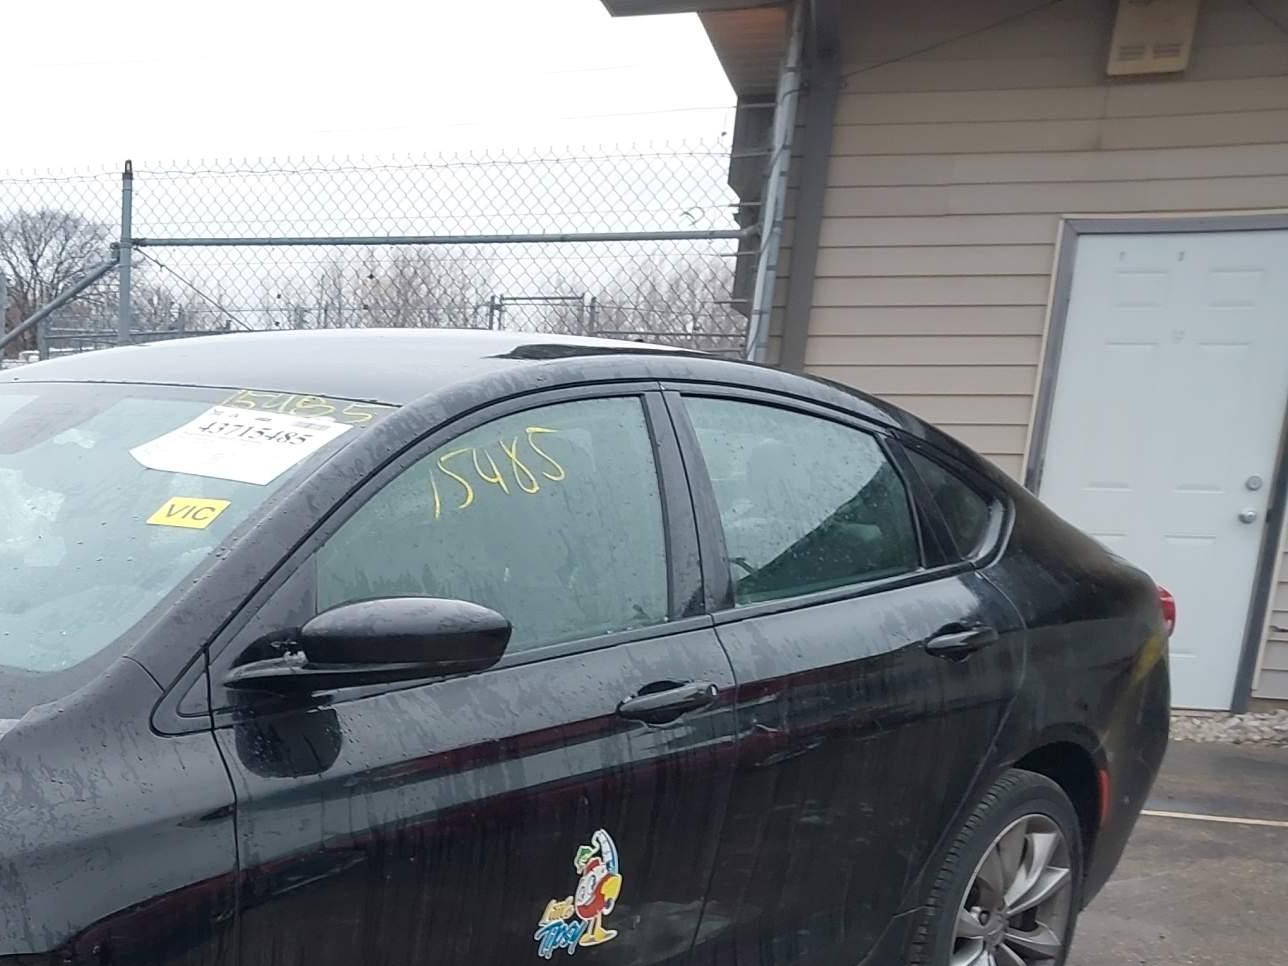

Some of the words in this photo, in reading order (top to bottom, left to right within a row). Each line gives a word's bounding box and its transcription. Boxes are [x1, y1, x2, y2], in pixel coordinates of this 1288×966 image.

[199, 421, 313, 446] 43715485
[428, 426, 566, 520] 15485
[163, 503, 217, 522] VIC
